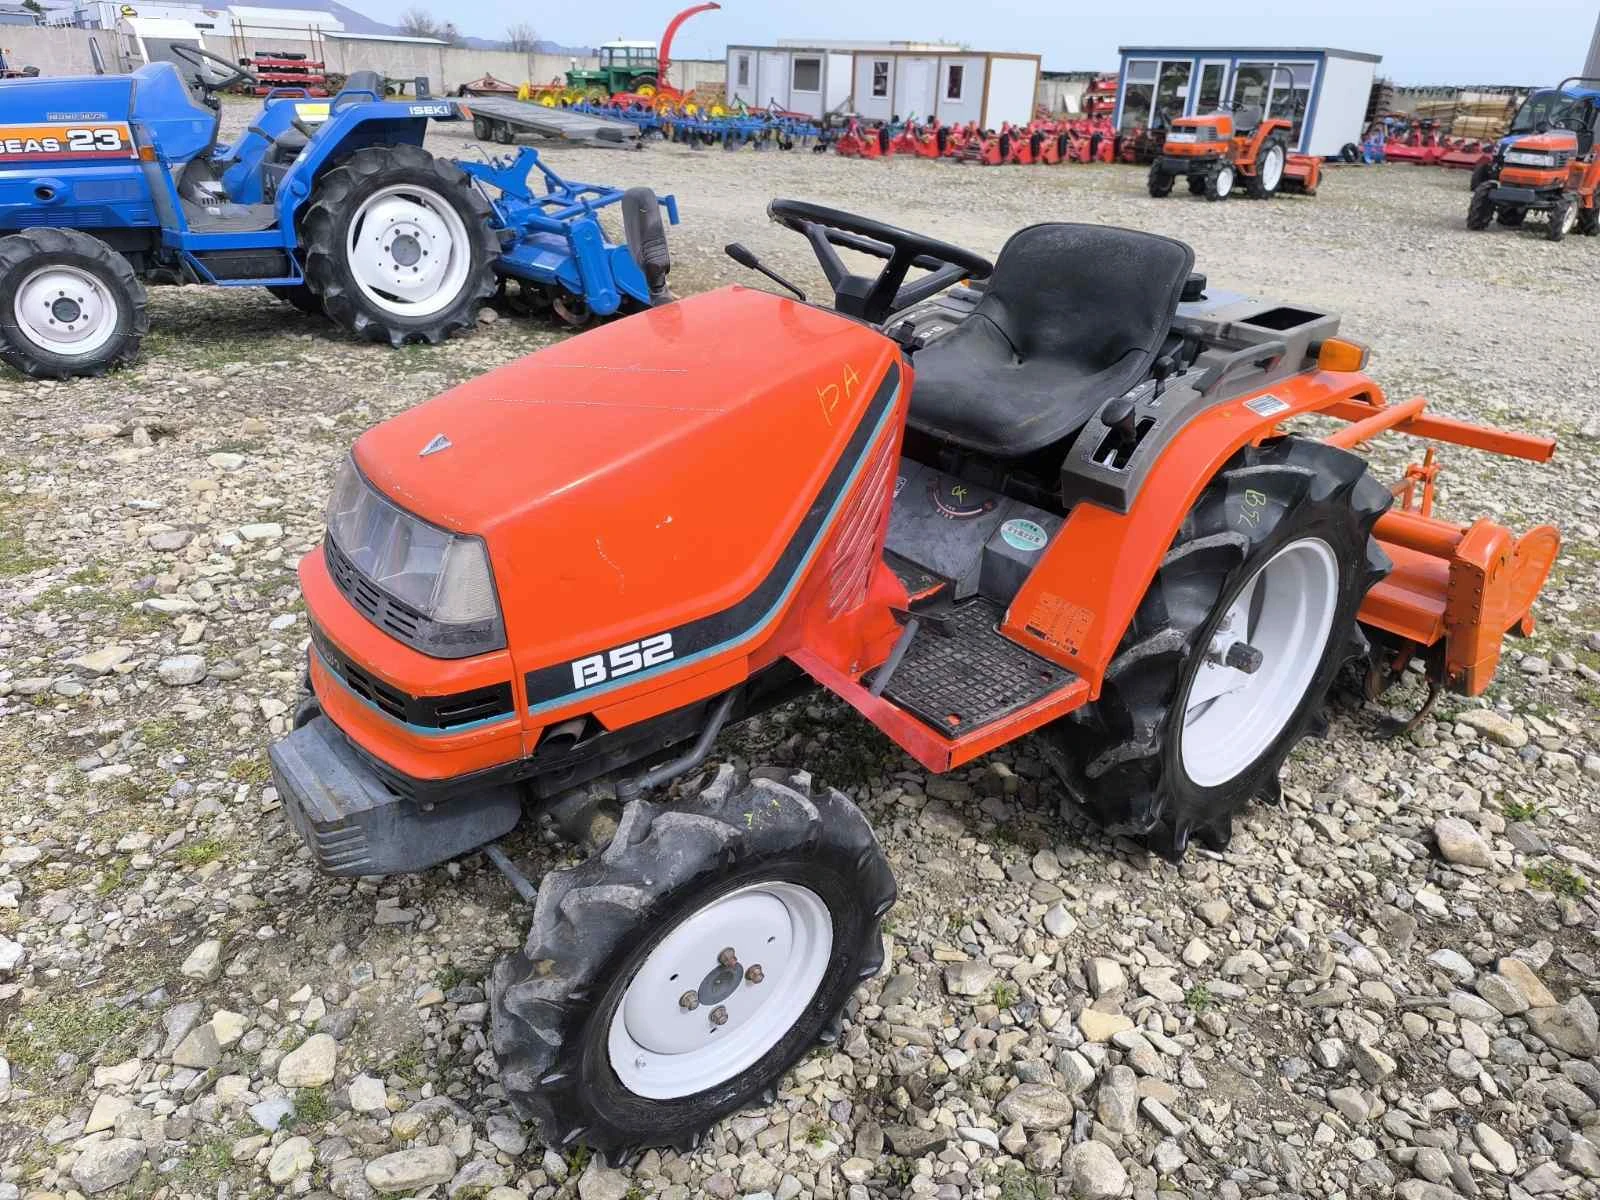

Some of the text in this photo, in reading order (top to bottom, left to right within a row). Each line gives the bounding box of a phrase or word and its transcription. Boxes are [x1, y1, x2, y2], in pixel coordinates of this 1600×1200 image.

[408, 105, 449, 115] ISEKI
[0, 129, 122, 154] EAS 23
[571, 632, 675, 690] B52
